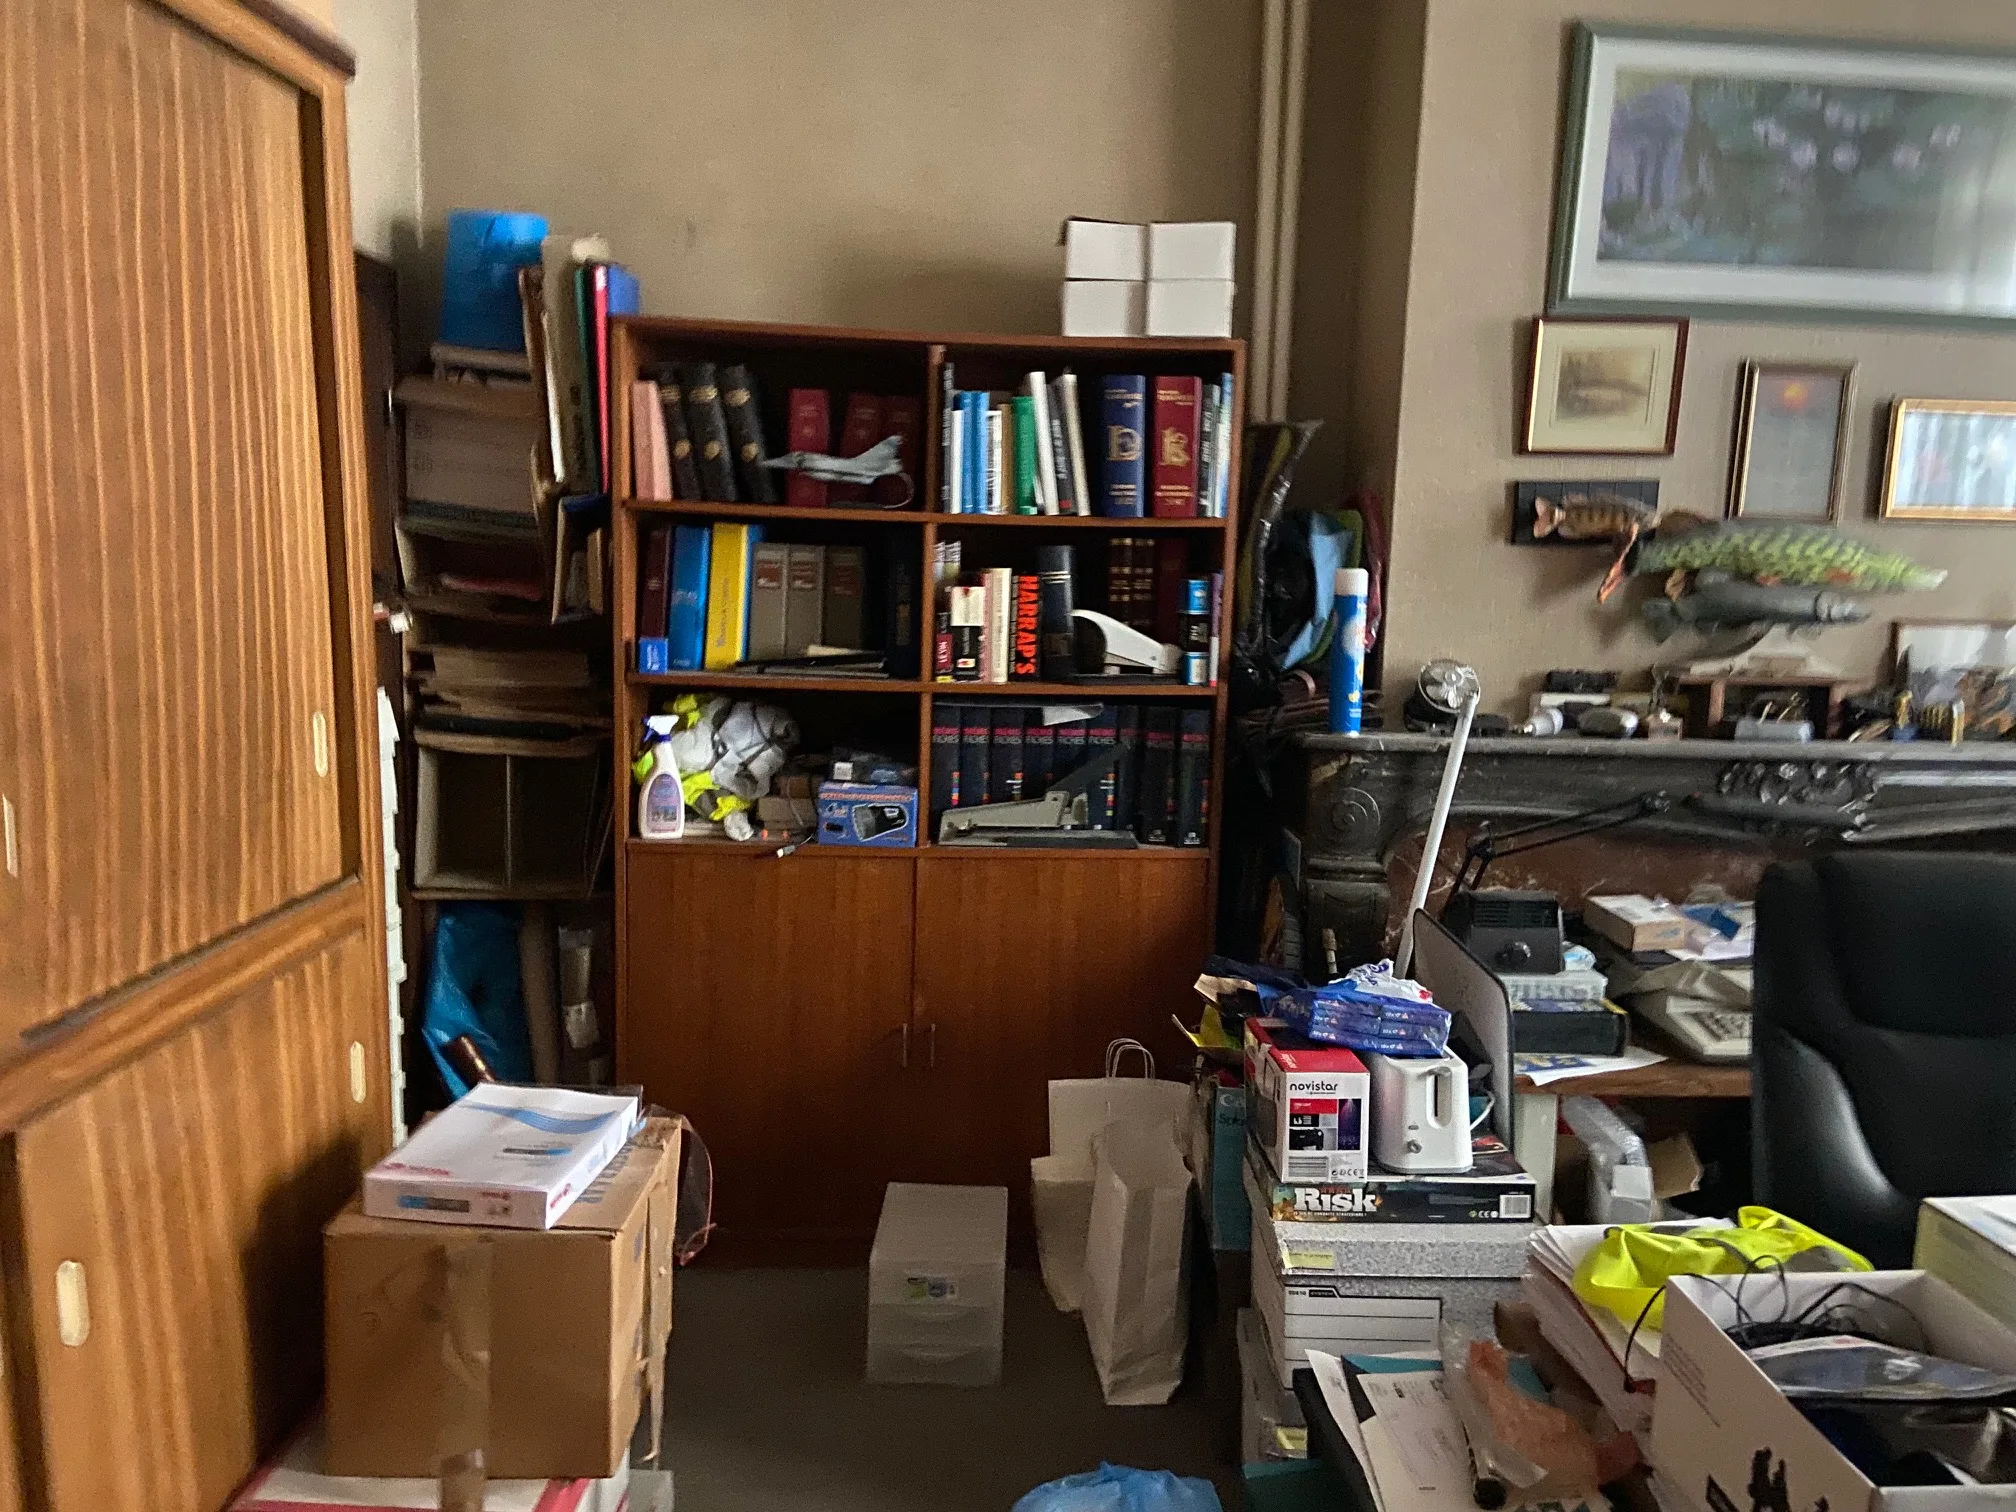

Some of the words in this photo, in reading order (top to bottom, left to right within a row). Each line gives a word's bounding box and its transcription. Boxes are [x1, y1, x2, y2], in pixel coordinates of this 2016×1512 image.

[1015, 575, 1040, 675] HARRAP'S
[1290, 1081, 1338, 1091] novistar
[1294, 1187, 1377, 1212] Risk
